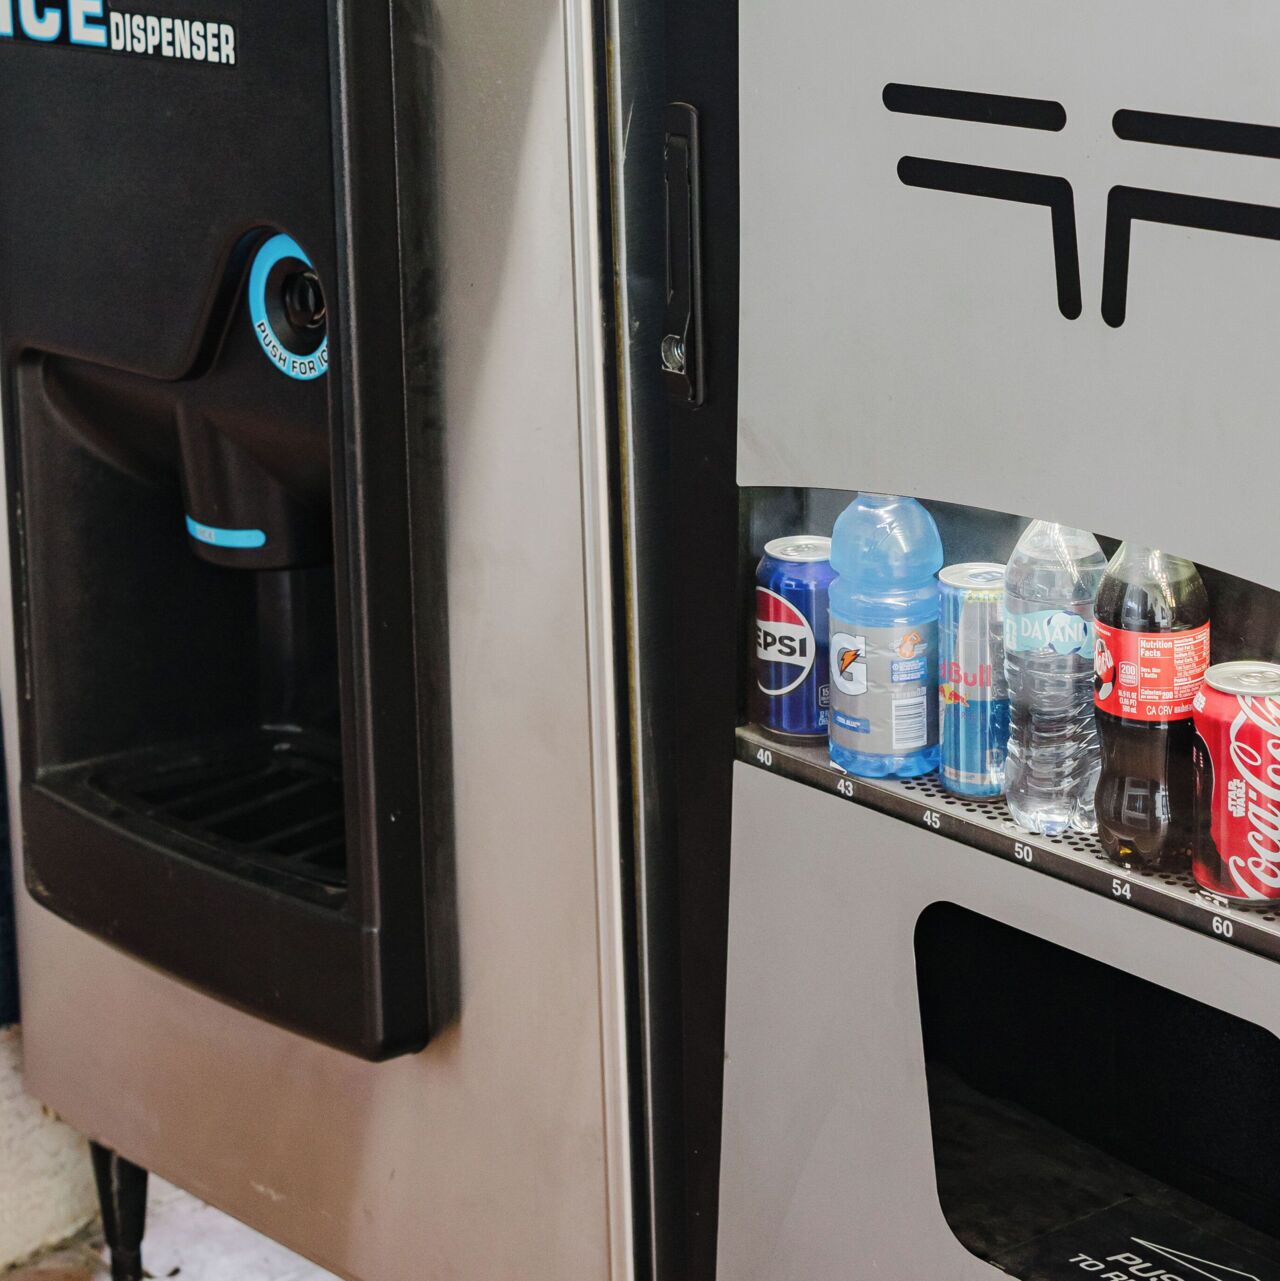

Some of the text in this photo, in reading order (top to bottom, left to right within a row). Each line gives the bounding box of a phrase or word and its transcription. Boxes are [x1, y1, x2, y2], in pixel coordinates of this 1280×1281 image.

[108, 11, 237, 67] DISPENSER
[256, 321, 328, 376] PUSH FOR IC
[1140, 639, 1173, 649] Nutrition
[1140, 649, 1161, 658] Facts
[831, 632, 868, 696] G
[1121, 664, 1136, 675] 200
[948, 661, 992, 688] Bull
[1161, 691, 1174, 700] 200
[1146, 705, 1157, 716] CA
[1157, 705, 1173, 716] CRV
[756, 747, 773, 767] 40
[836, 778, 854, 798] 43
[922, 809, 941, 830] 45
[1014, 842, 1033, 864] 50
[1111, 878, 1131, 901] 54
[1212, 916, 1234, 939] 60
[1069, 1253, 1106, 1271] TO
